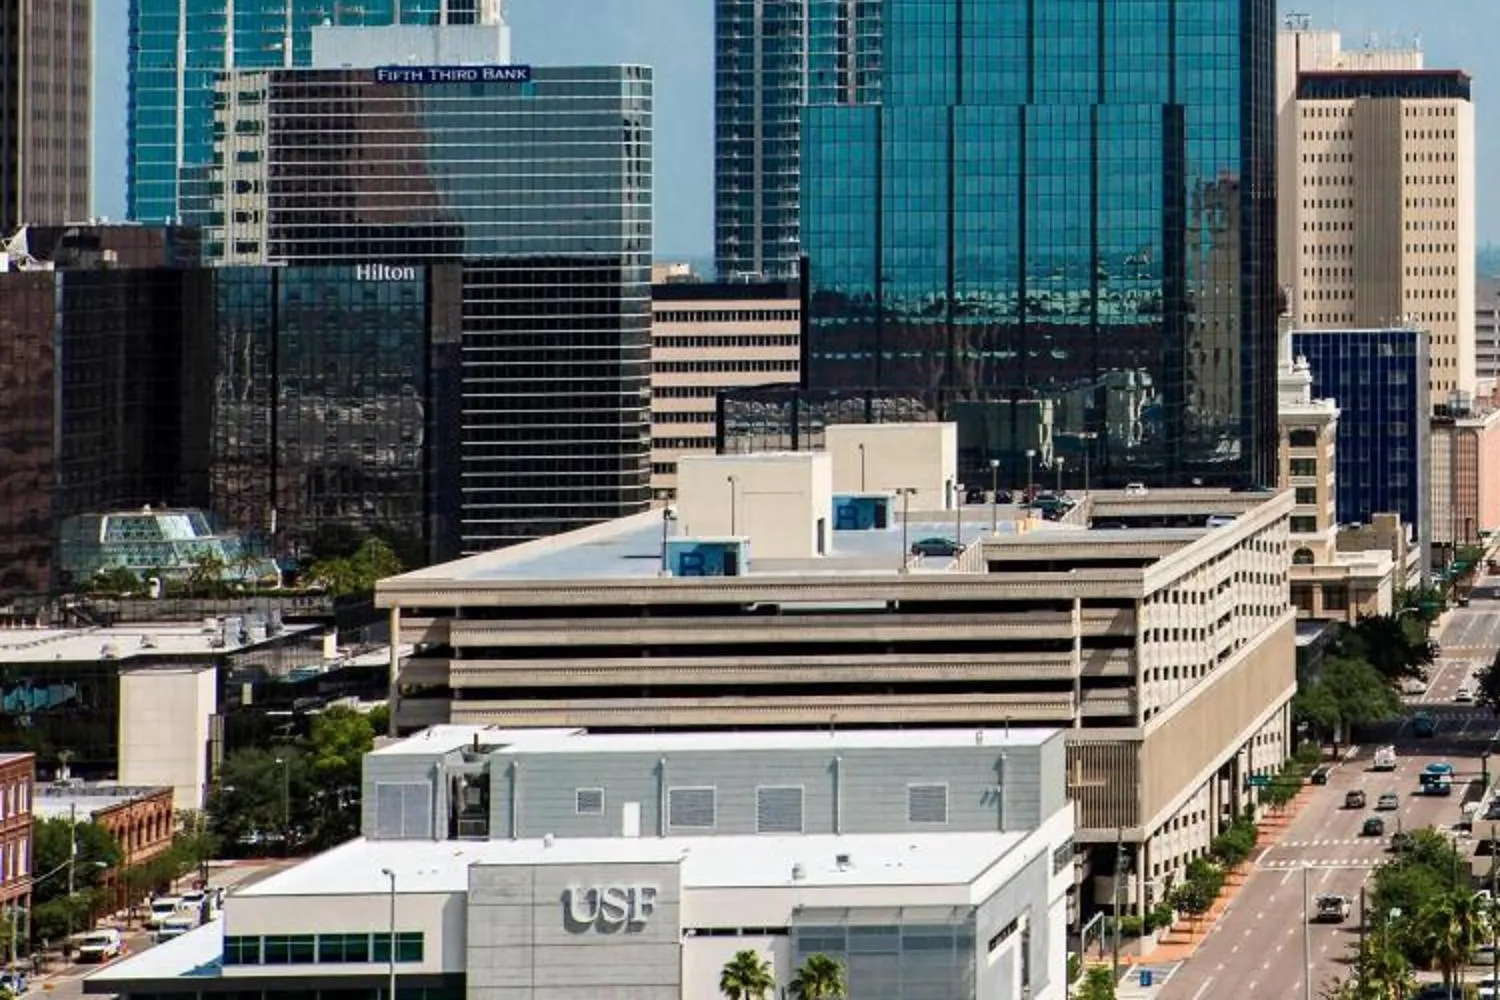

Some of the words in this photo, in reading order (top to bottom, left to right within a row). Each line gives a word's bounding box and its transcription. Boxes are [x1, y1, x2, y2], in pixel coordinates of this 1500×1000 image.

[378, 69, 423, 81] FIFTH
[428, 68, 478, 81] THIRD
[482, 67, 527, 80] BANK
[356, 263, 415, 281] Hilton
[565, 882, 661, 923] USF
